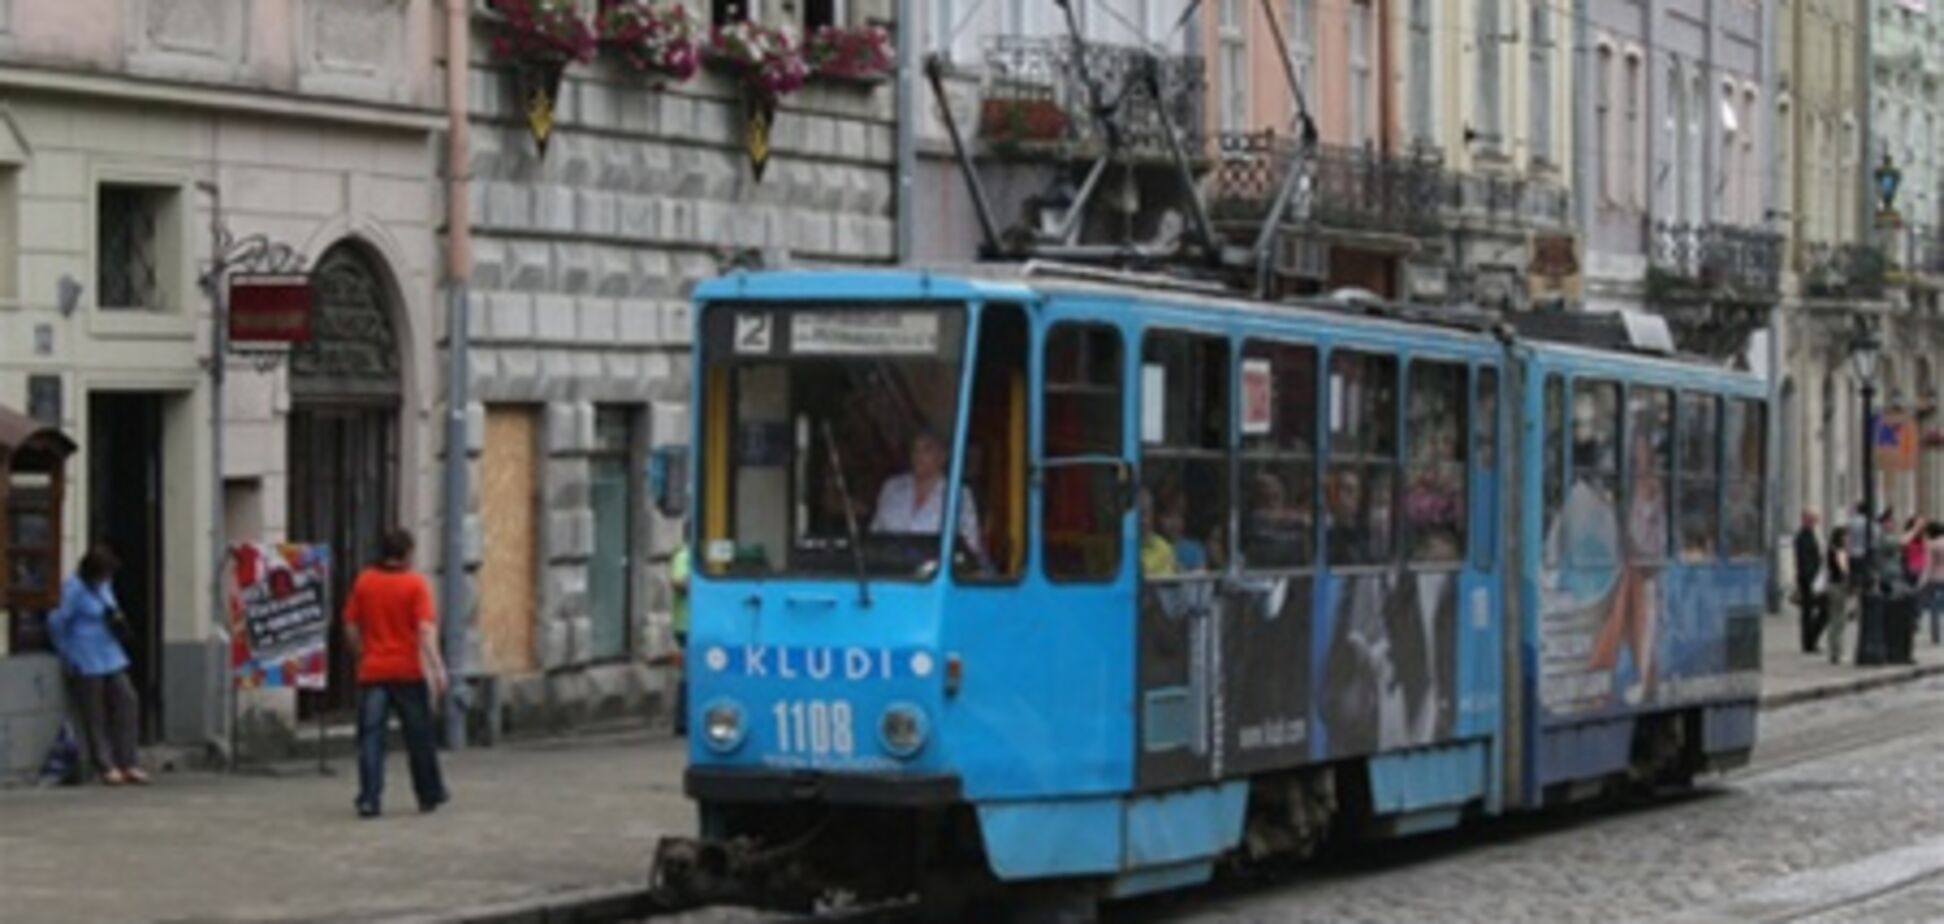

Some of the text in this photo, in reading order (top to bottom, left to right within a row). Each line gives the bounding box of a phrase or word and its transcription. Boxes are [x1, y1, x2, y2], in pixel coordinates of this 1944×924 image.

[740, 311, 767, 346] 2
[745, 646, 893, 679] KLUDI
[773, 701, 854, 753] 1108
